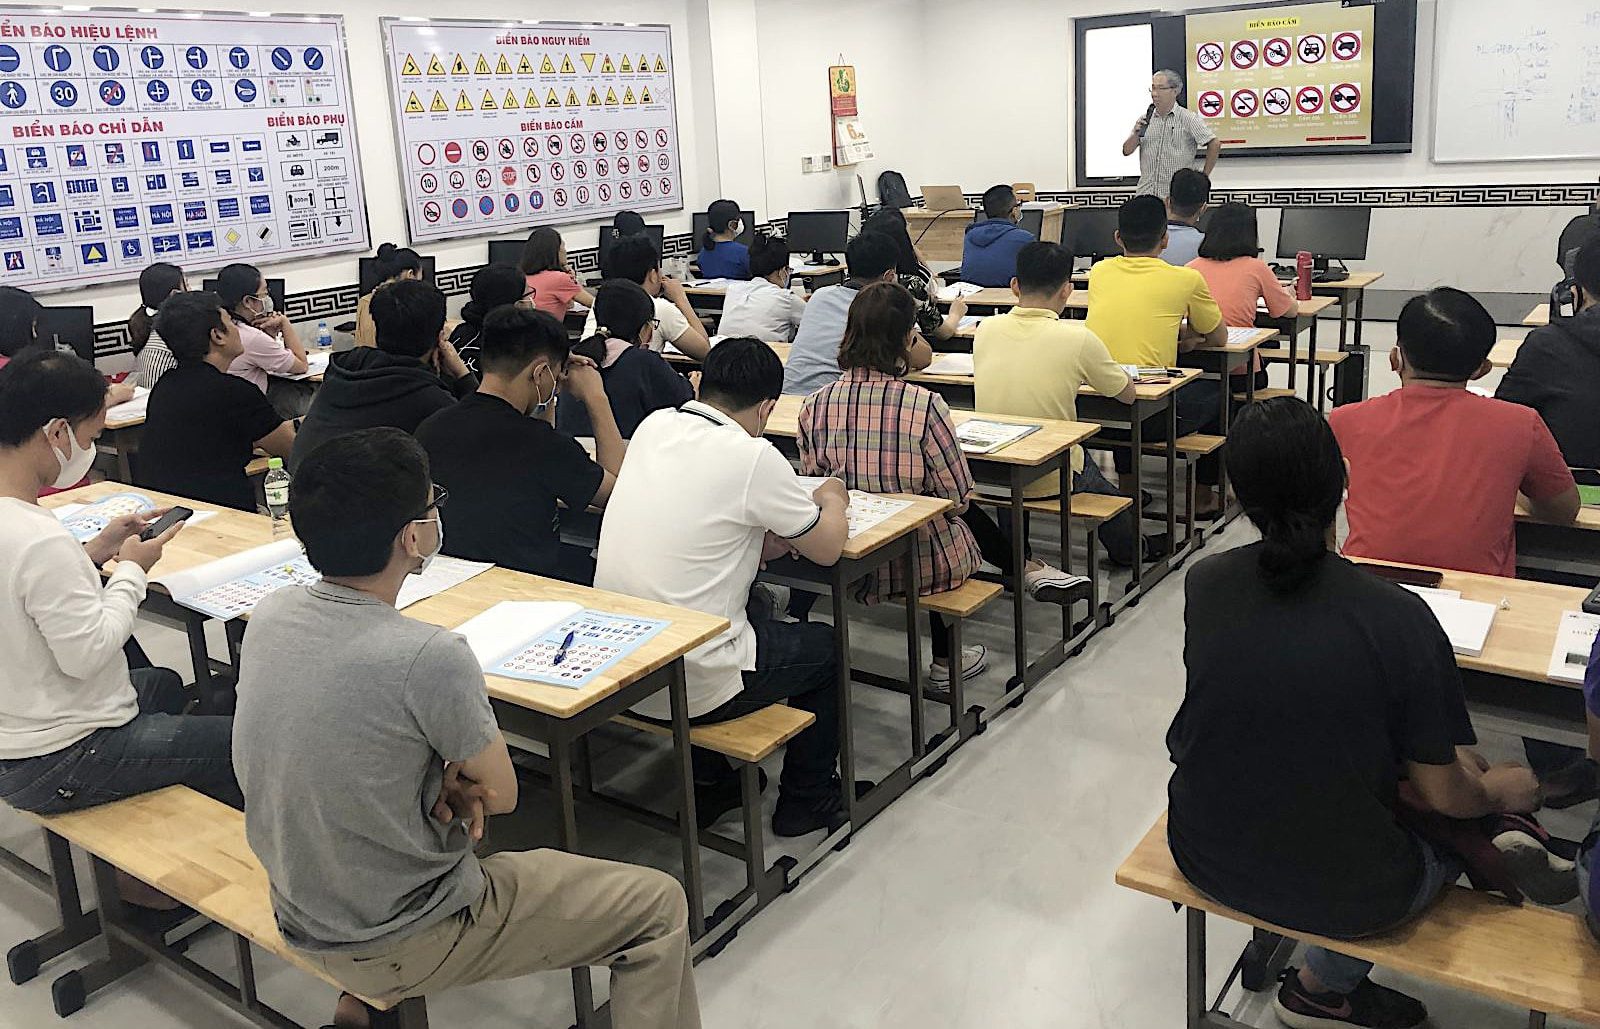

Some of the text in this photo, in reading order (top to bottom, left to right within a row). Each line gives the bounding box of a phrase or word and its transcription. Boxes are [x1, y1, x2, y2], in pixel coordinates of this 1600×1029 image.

[1282, 17, 1297, 25] CẤM
[30, 22, 66, 38] BÁO
[71, 24, 111, 41] HIỆU
[116, 25, 158, 42] LỆNH
[496, 31, 590, 46] BIỂN BÁO NGUY HIỂM
[55, 87, 75, 100] 30
[267, 111, 345, 127] BIỂN BÁO PHỤ
[520, 117, 583, 132] BIỂN BÁO CẤM
[13, 116, 164, 138] BIỂN BÁO CHỈ DẪN
[660, 158, 668, 166] 20
[503, 172, 517, 180] STOP
[151, 210, 172, 220] HÀ NỘI
